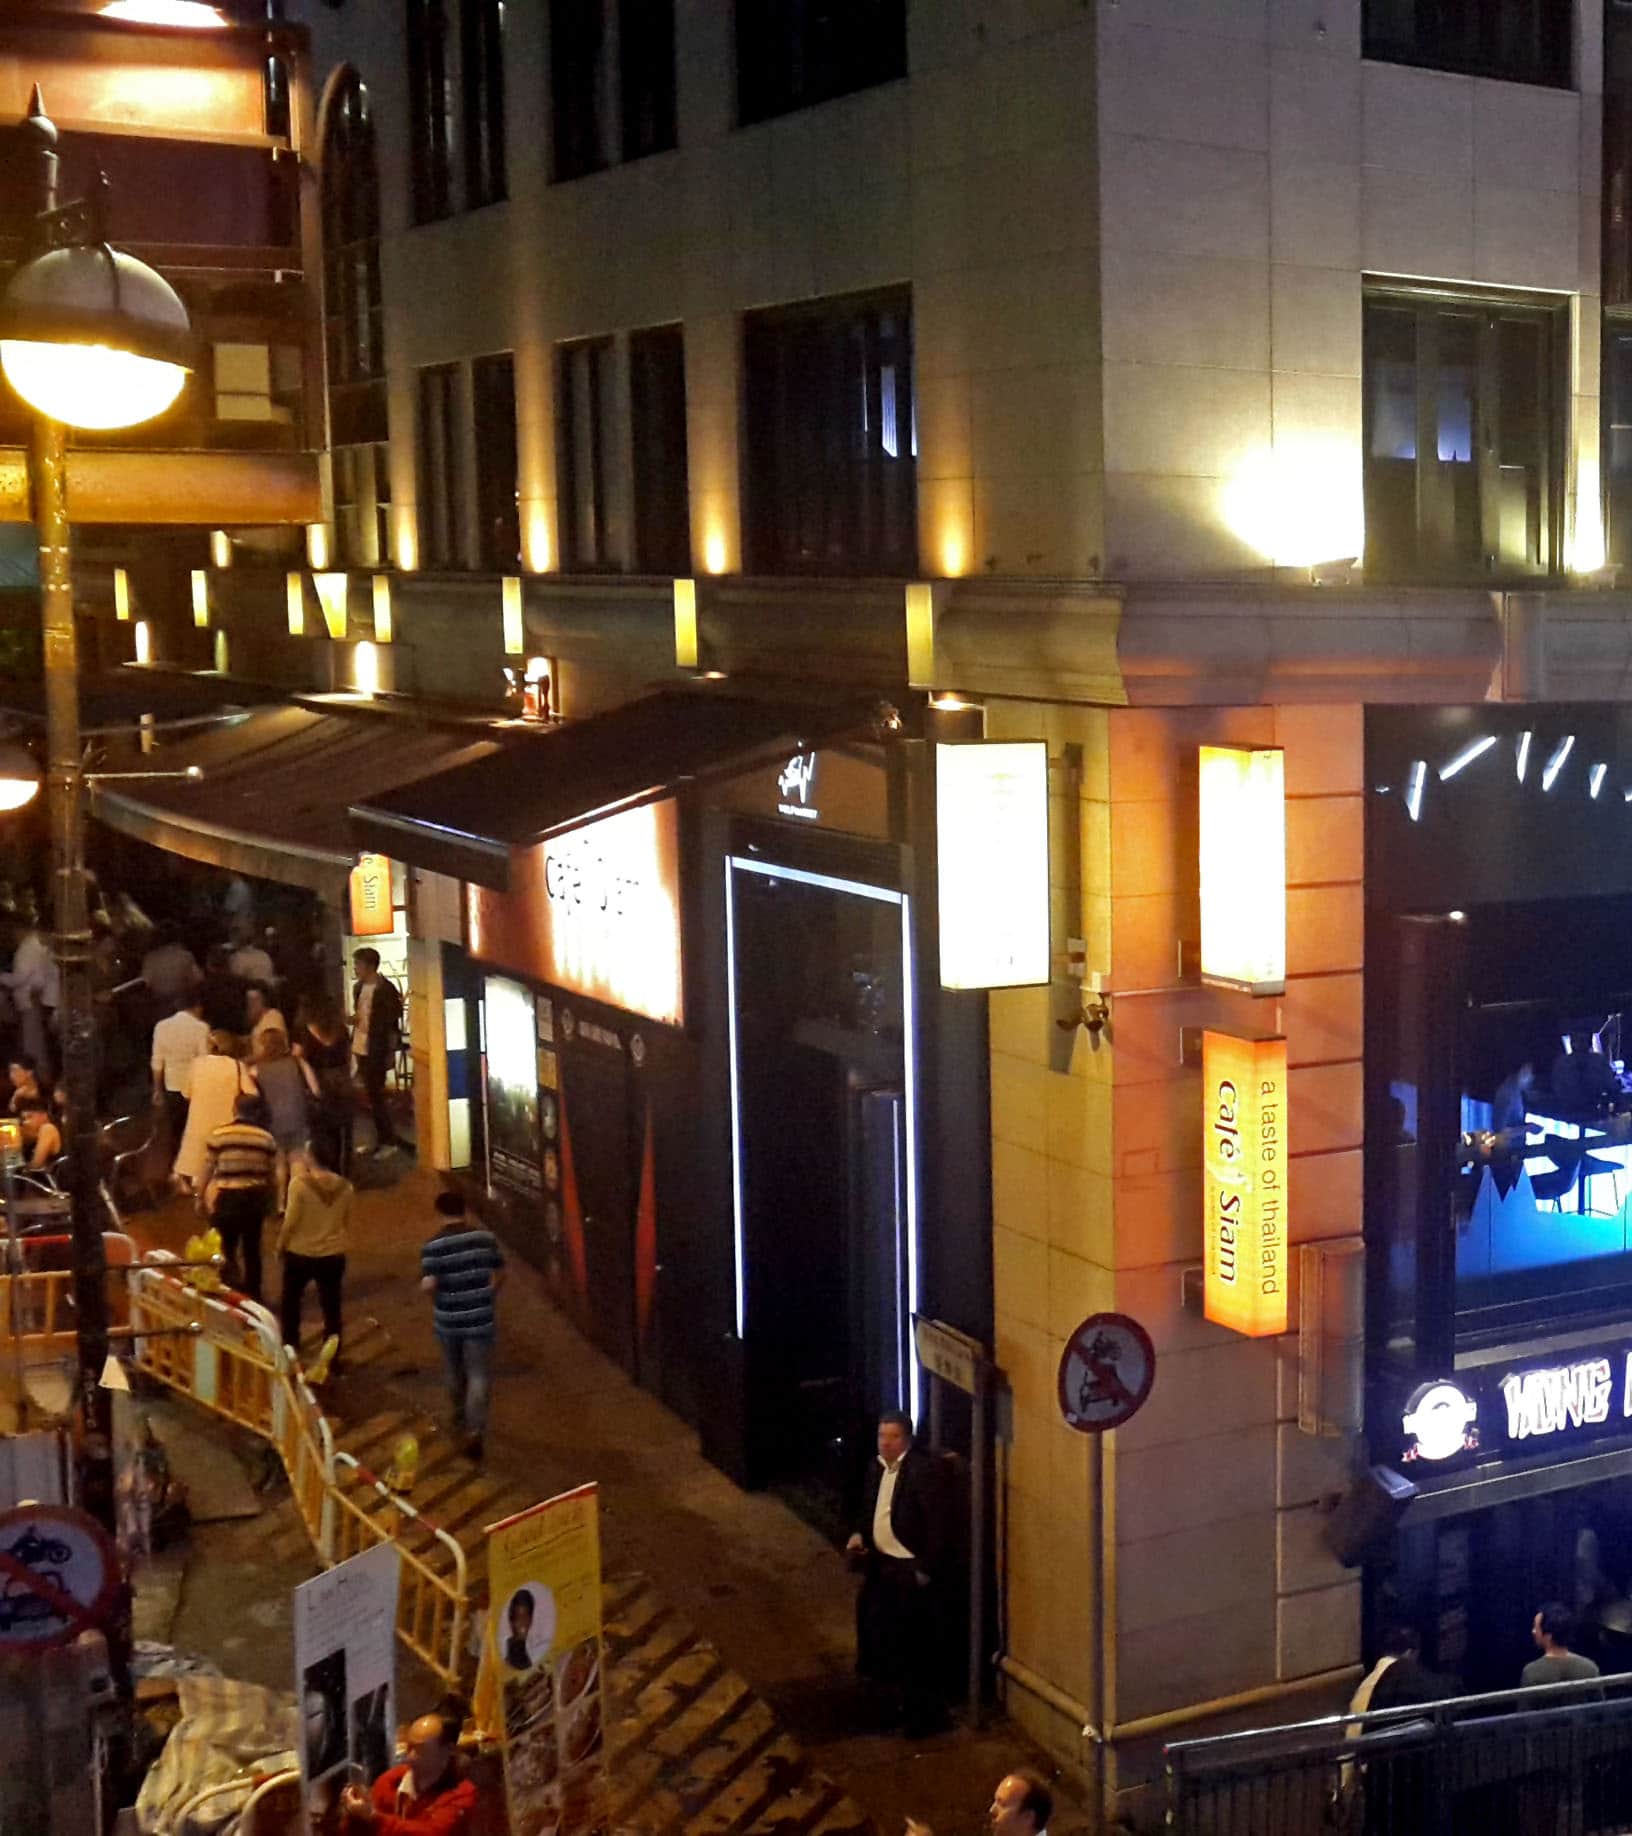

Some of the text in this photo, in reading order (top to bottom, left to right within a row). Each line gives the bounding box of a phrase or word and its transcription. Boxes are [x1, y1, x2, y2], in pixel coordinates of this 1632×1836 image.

[1214, 1080, 1242, 1283] Café Siam
[1260, 1080, 1281, 1295] a taste of thailand
[1501, 1356, 1614, 1440] HONG
